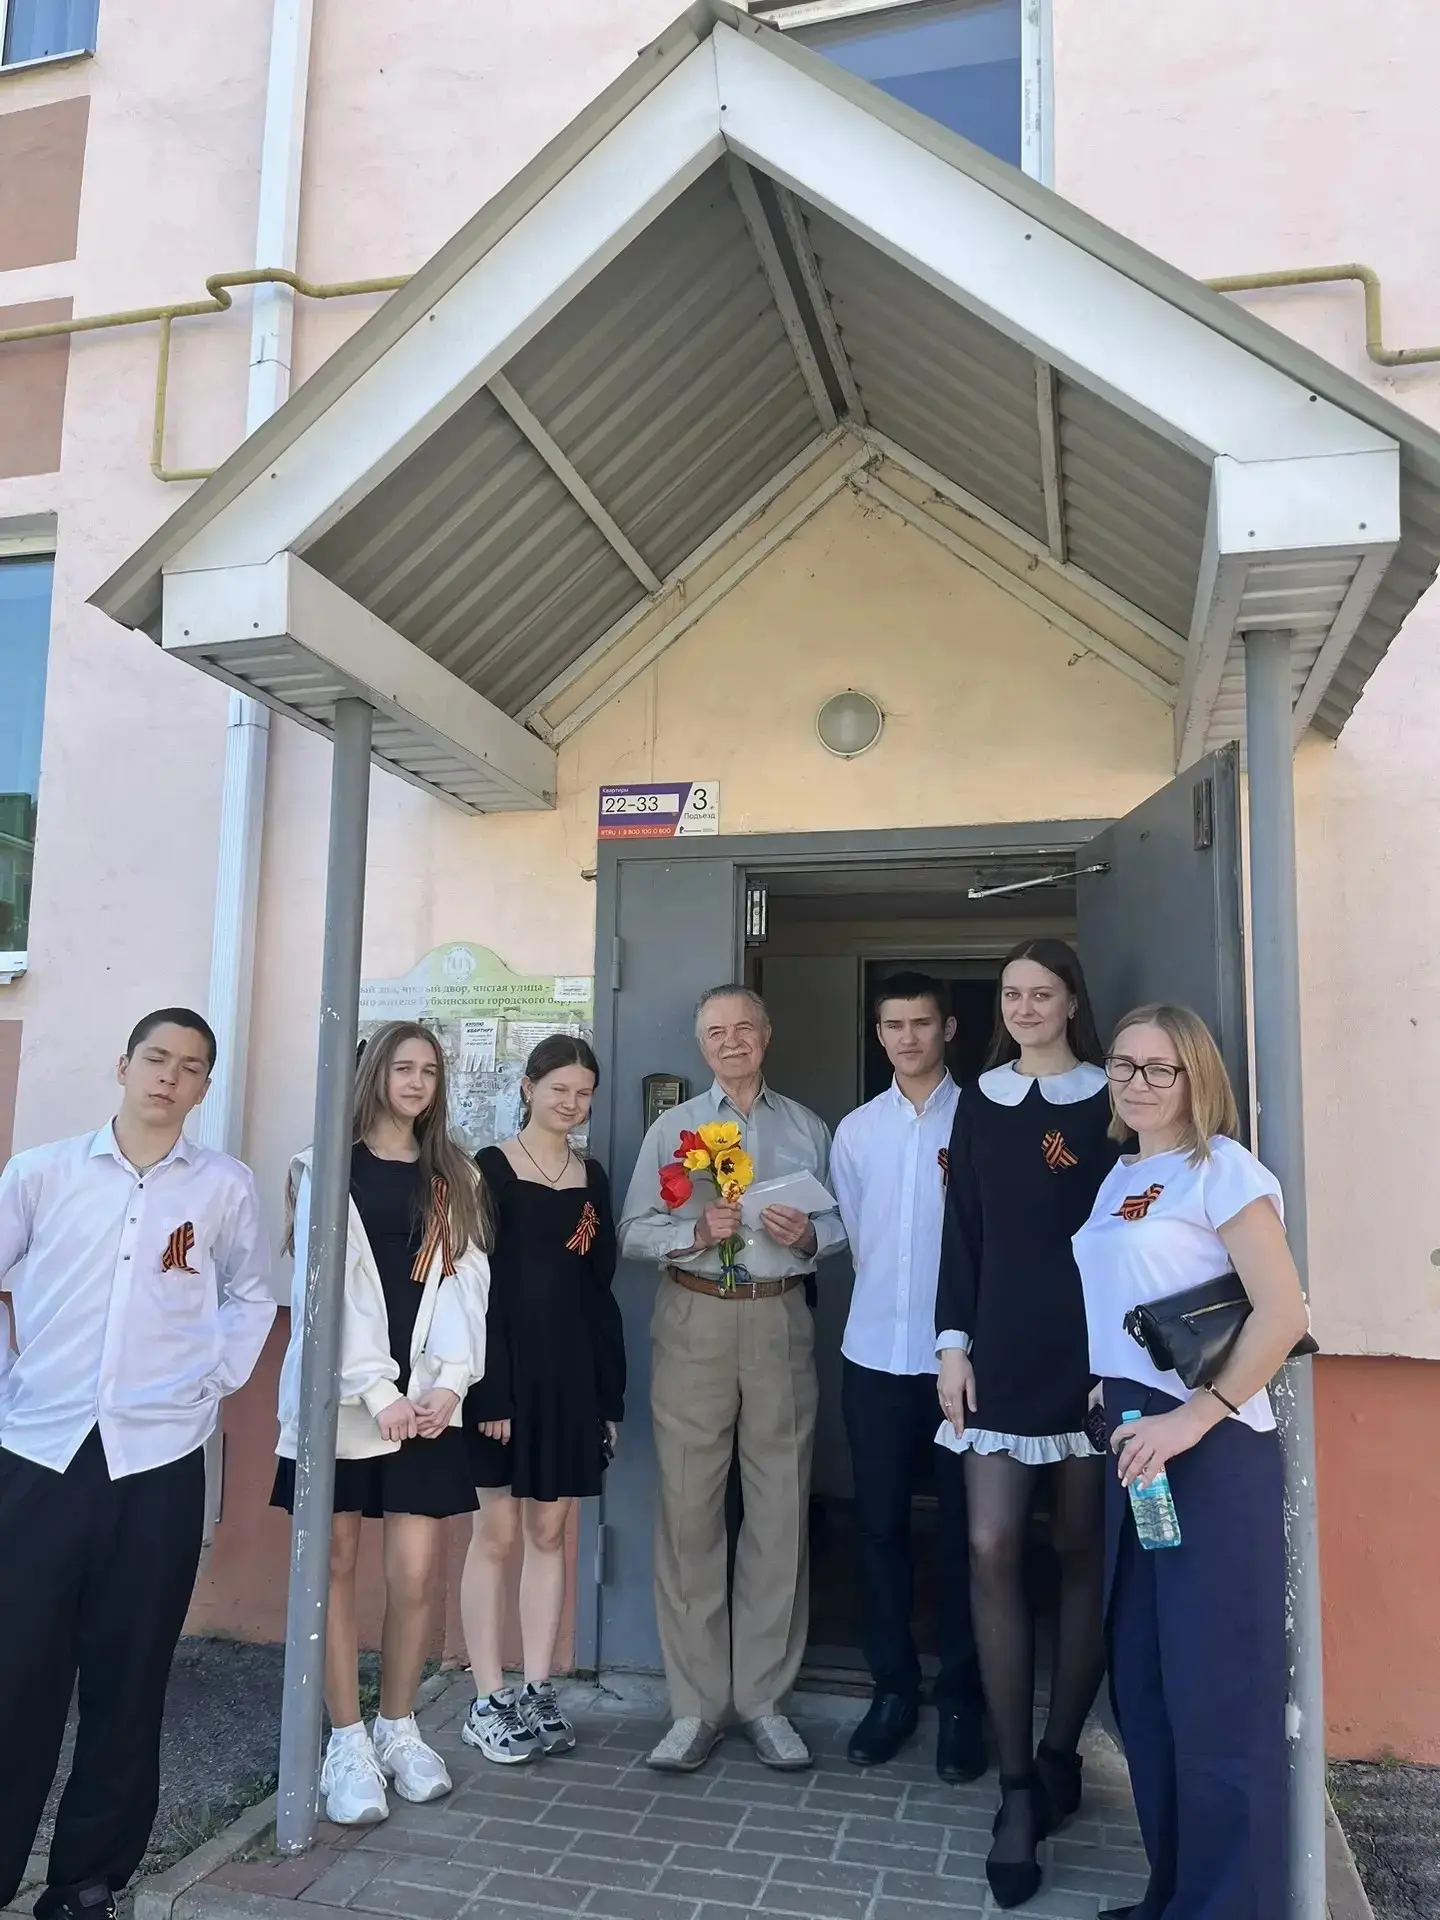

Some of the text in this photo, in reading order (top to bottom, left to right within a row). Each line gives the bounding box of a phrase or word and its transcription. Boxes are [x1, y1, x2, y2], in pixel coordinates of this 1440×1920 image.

[605, 796, 659, 813] 22-33
[692, 788, 708, 811] 3
[684, 812, 716, 820] Подъезд
[442, 984, 471, 996] двор,
[473, 985, 508, 993] чистая
[511, 984, 544, 994] улица
[420, 996, 485, 1008] Губкинского
[487, 996, 545, 1007] городского
